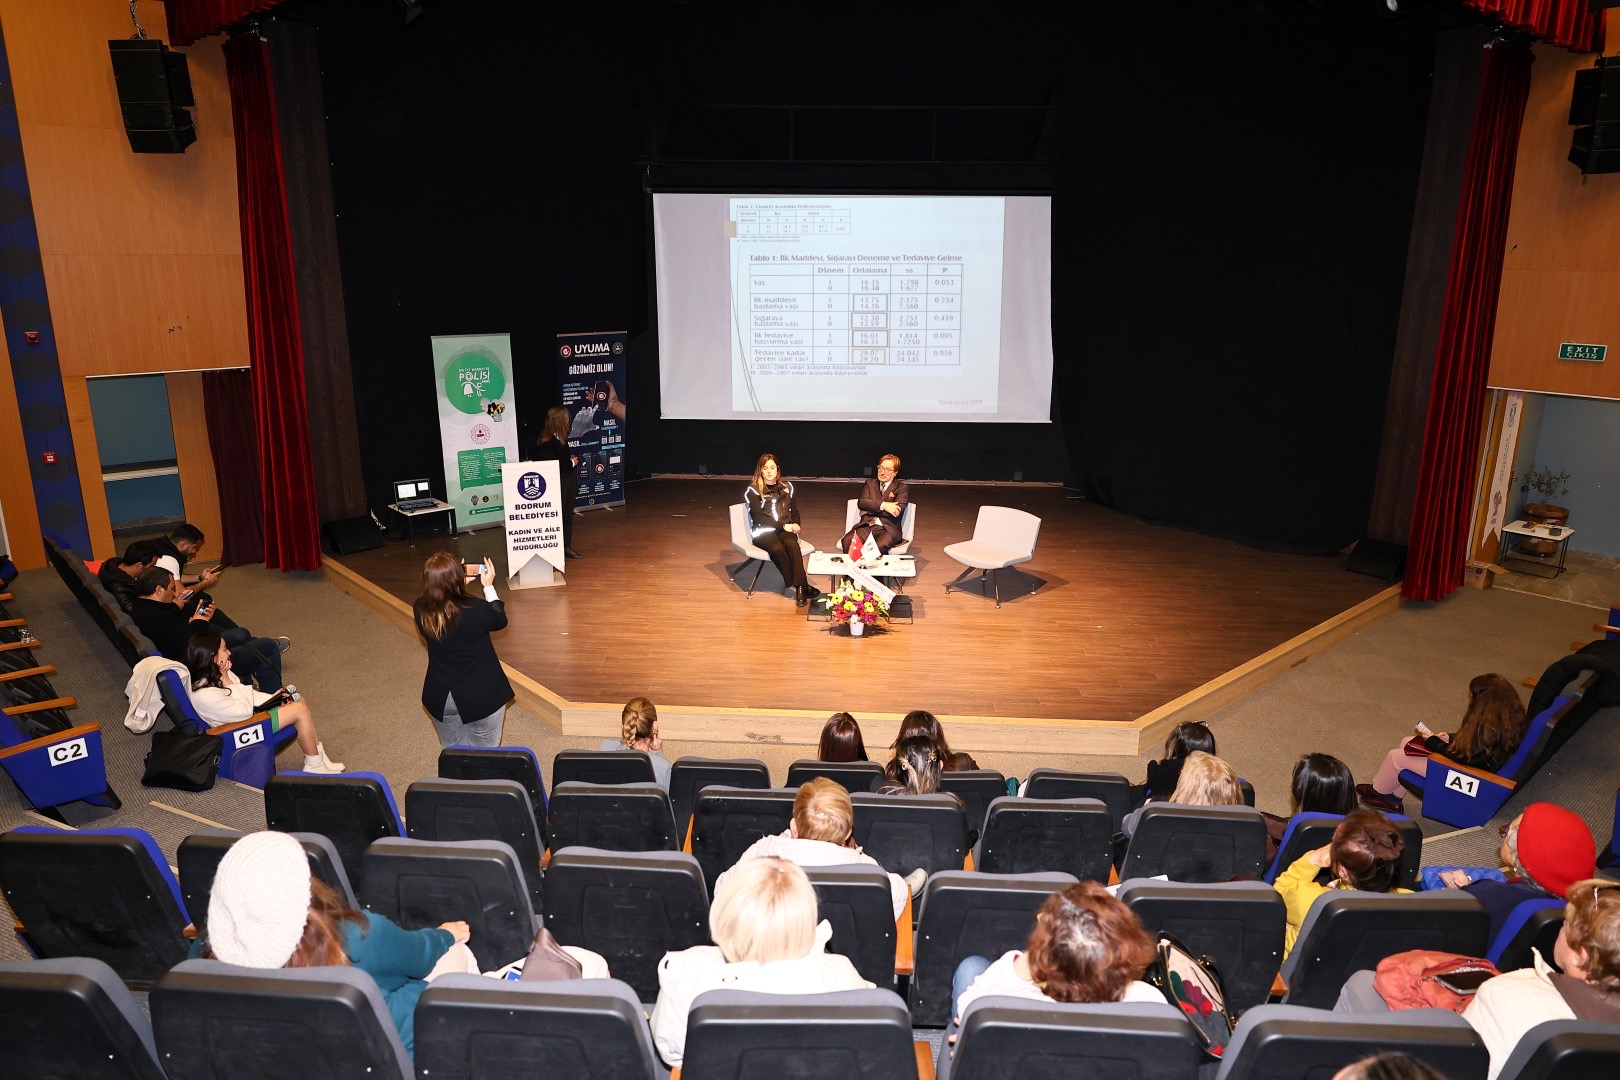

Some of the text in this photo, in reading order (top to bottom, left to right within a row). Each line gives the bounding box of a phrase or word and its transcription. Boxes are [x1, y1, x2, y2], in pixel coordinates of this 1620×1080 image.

[575, 343, 610, 353] UYUMA
[569, 363, 613, 375] GÖZÜMÜZ OLUN!
[515, 502, 551, 510] BODRUM
[509, 510, 558, 520] BELEDİYESİ
[513, 542, 558, 551] MÜDÜRLÜĞÜ
[238, 728, 261, 745] C1
[53, 743, 83, 762] C2
[1450, 776, 1473, 793] A1
